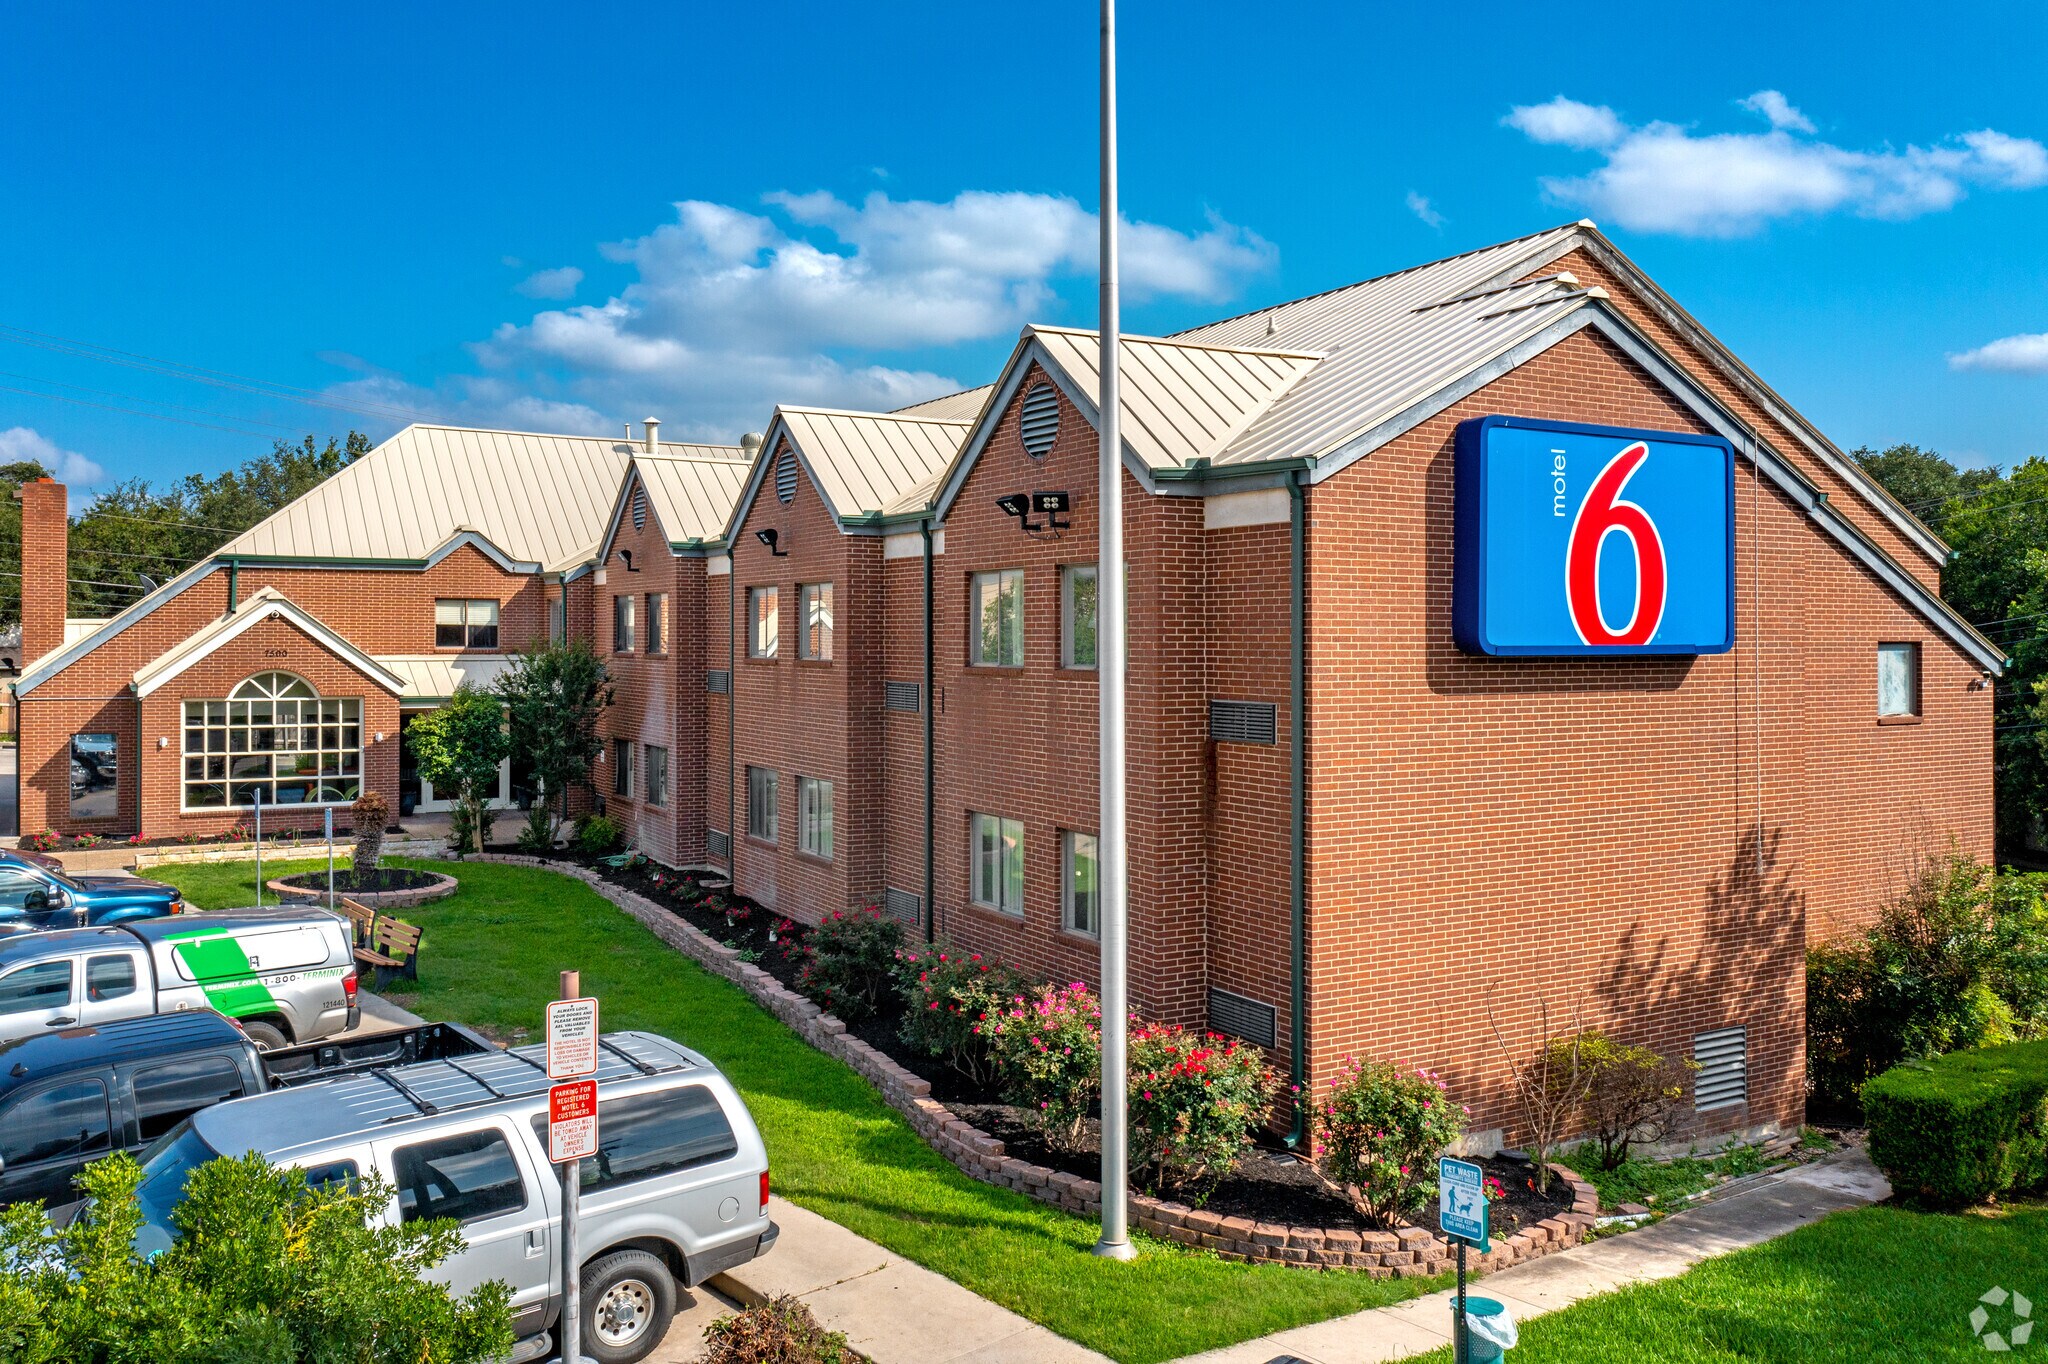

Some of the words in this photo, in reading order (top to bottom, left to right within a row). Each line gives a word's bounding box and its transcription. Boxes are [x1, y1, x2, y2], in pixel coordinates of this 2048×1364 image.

[1550, 449, 1566, 517] motel
[1565, 441, 1667, 646] 6
[204, 979, 258, 991] TERMINIX.COM
[322, 999, 345, 1009] 121440
[555, 1088, 578, 1097] PARKING
[557, 1094, 590, 1105] REGISTERED
[562, 1103, 579, 1111] MOTEL
[558, 1108, 589, 1120] CUSTOMERS
[554, 1120, 580, 1130] VIOLATORS
[568, 1132, 587, 1140] VEHICLE
[563, 1145, 584, 1154] EXPENSE
[1444, 1164, 1456, 1173] PET
[1457, 1167, 1478, 1179] WASTE
[1449, 1215, 1463, 1223] PLEASE
[1466, 1225, 1478, 1233] CLEAN
